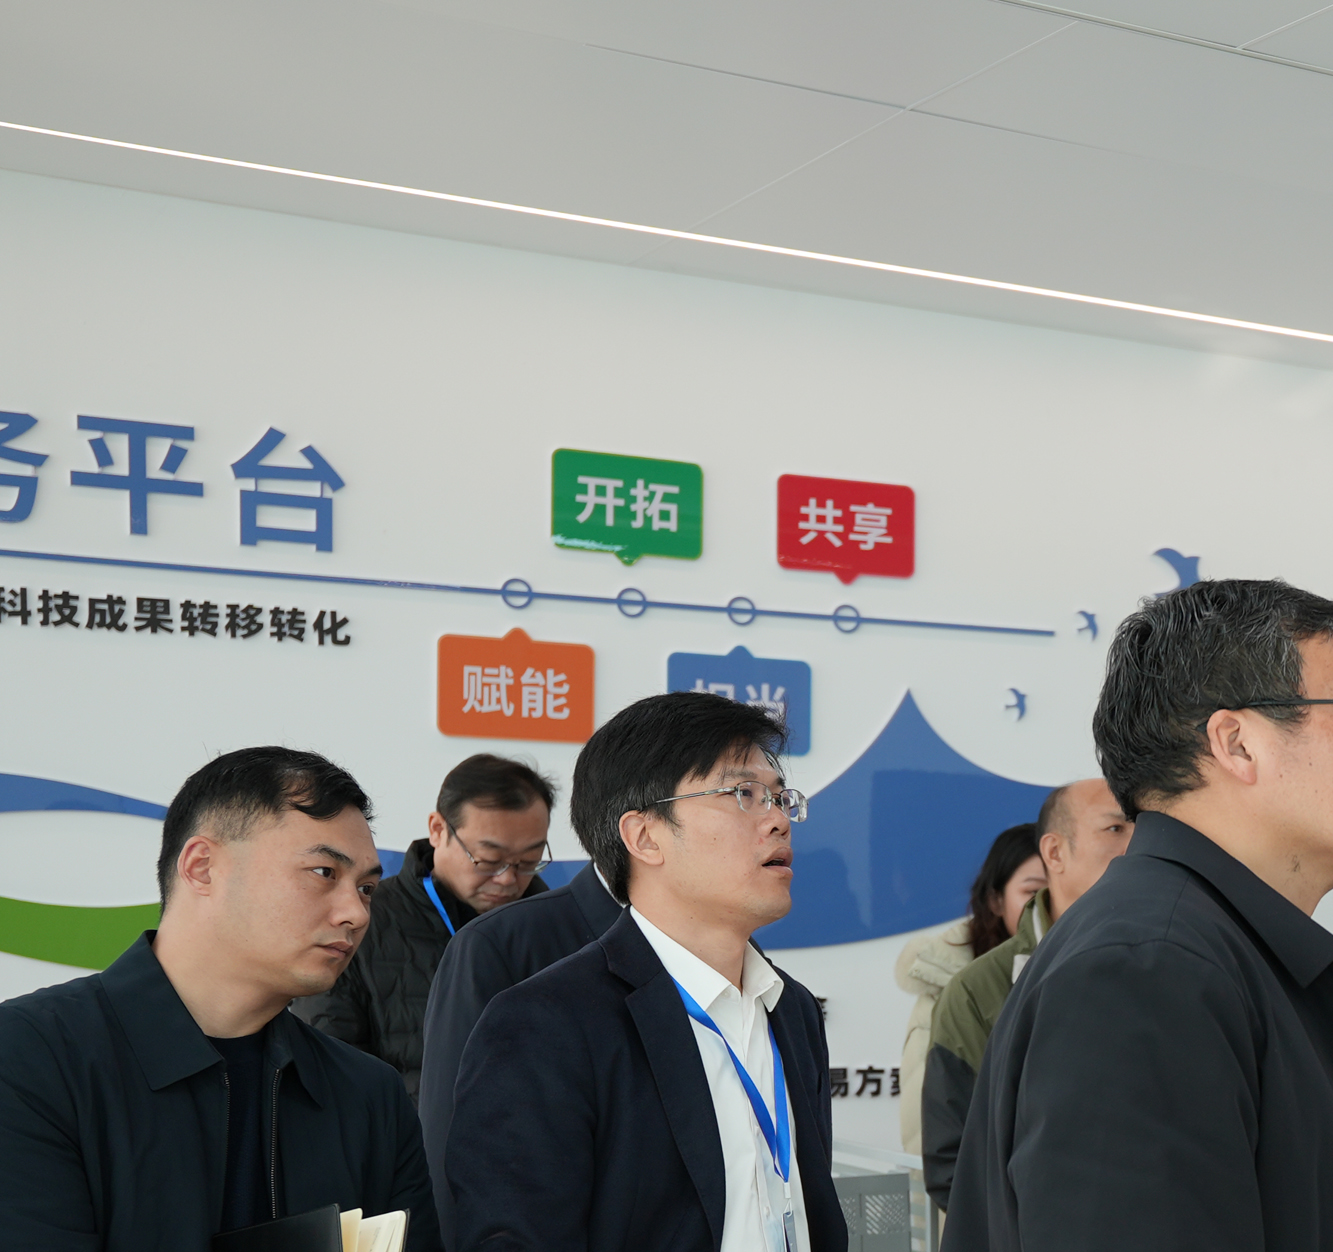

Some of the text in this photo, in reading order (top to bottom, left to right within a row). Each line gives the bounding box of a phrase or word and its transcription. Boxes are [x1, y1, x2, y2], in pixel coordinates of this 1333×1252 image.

[574, 474, 680, 533] 开拓
[797, 496, 894, 552] 共享
[0, 586, 352, 647] 科技成果转移转化
[461, 664, 571, 721] 赋能
